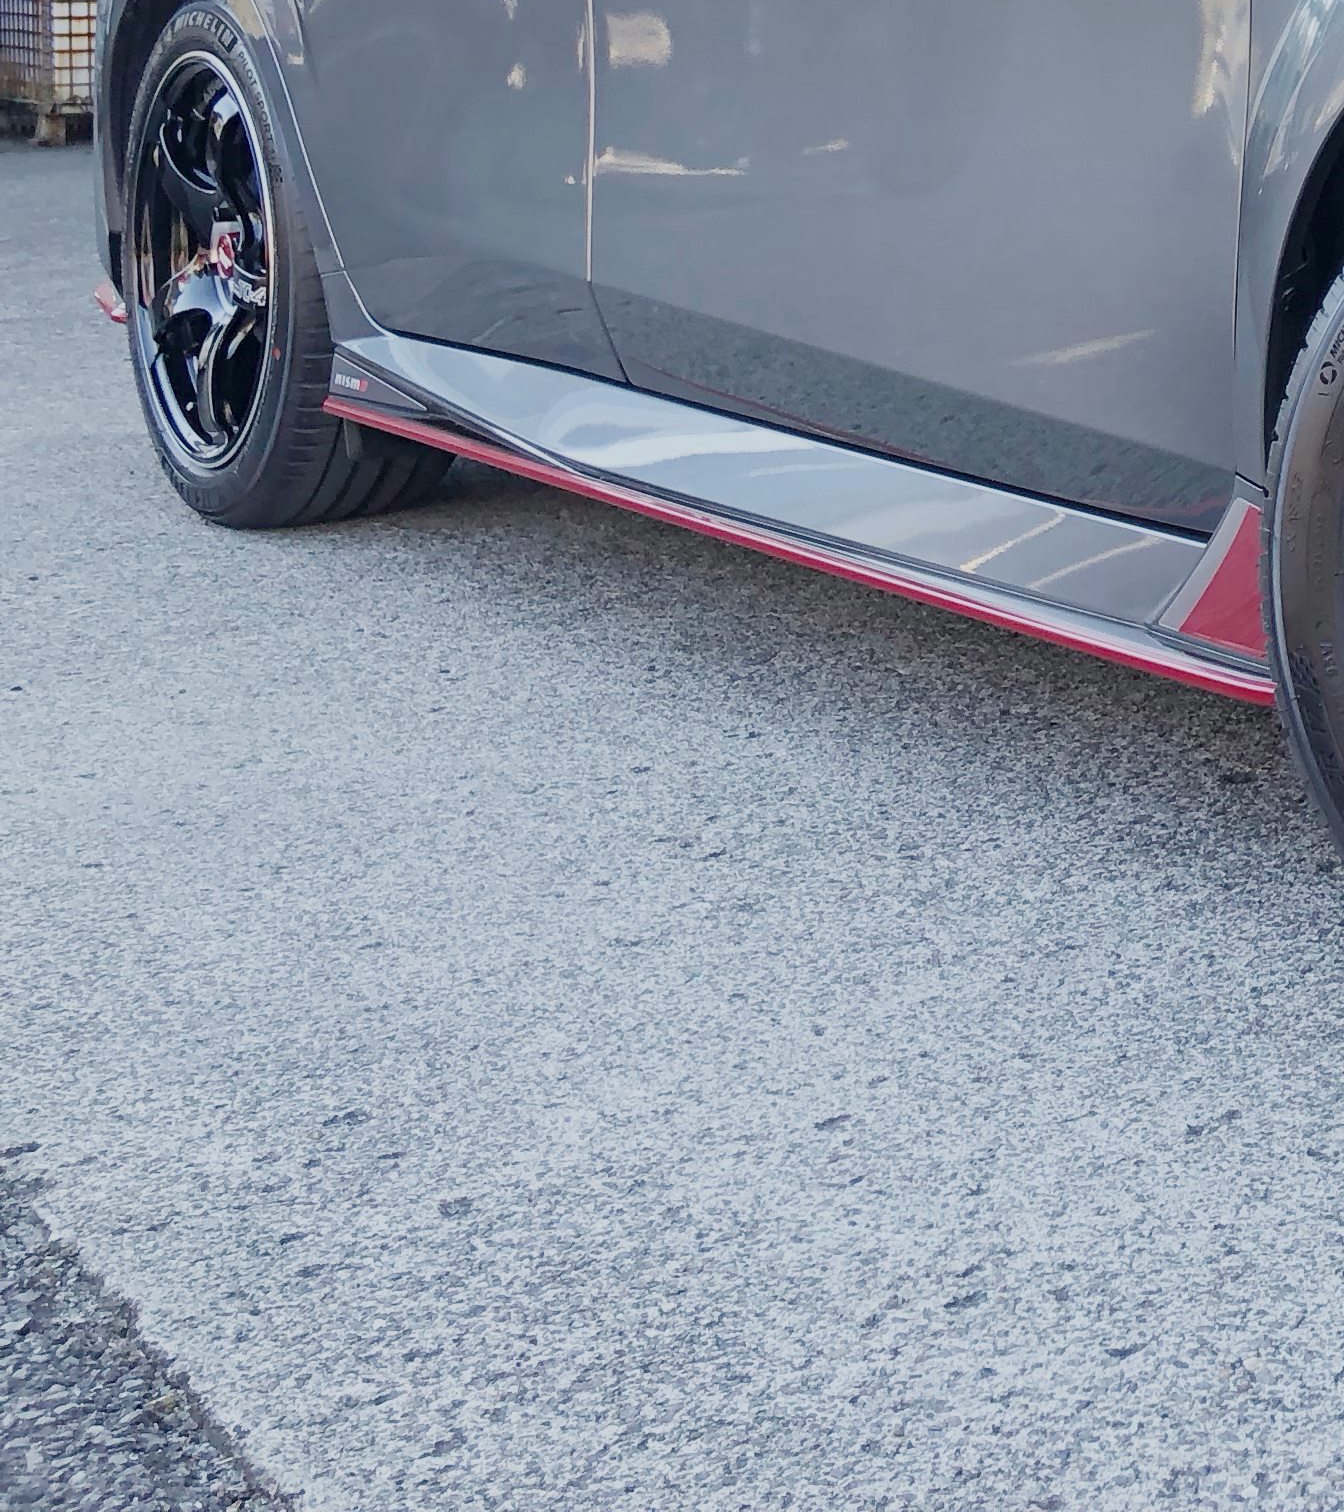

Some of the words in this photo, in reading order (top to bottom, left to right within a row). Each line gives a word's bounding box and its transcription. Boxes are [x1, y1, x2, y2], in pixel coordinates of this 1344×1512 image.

[174, 10, 234, 50] MICHELIN
[237, 50, 258, 87] PILOT
[255, 91, 275, 142] SPORT
